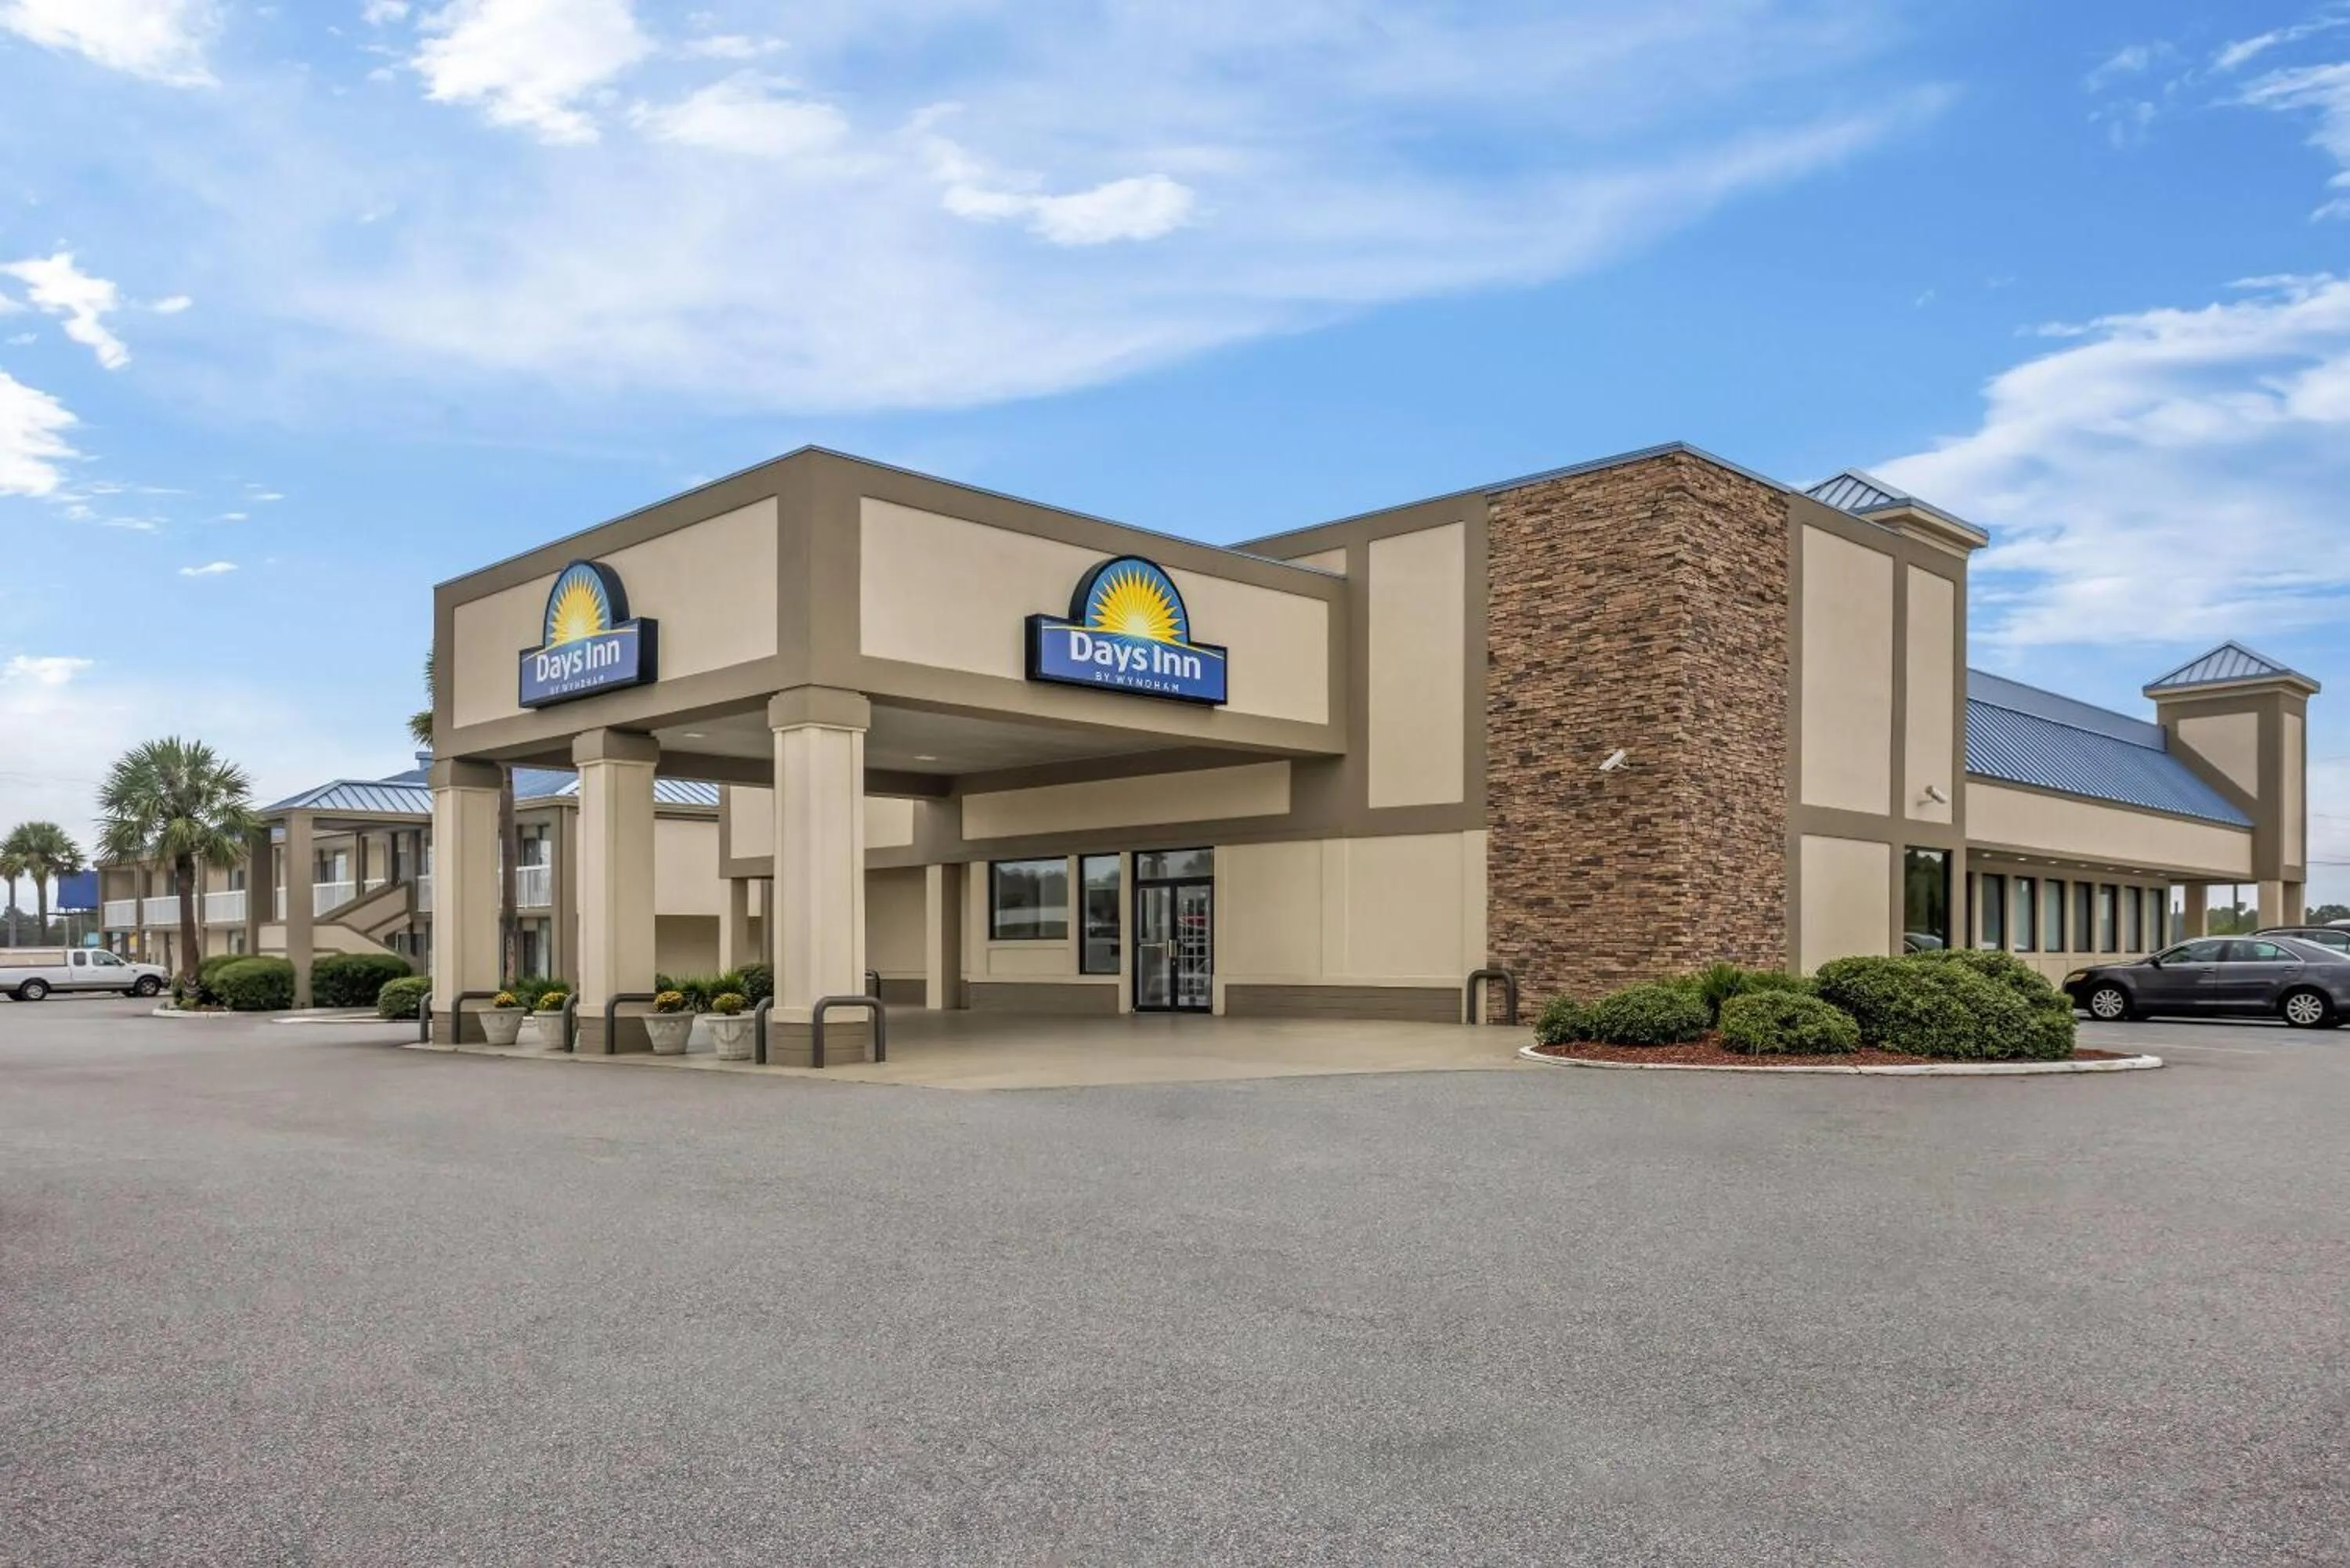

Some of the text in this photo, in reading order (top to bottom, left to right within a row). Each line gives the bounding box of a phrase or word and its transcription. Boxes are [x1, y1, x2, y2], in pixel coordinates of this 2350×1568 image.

[536, 639, 620, 683] Days Inn
[1069, 631, 1201, 680] Days Inn
[1095, 671, 1180, 692] BY WYNDHAM
